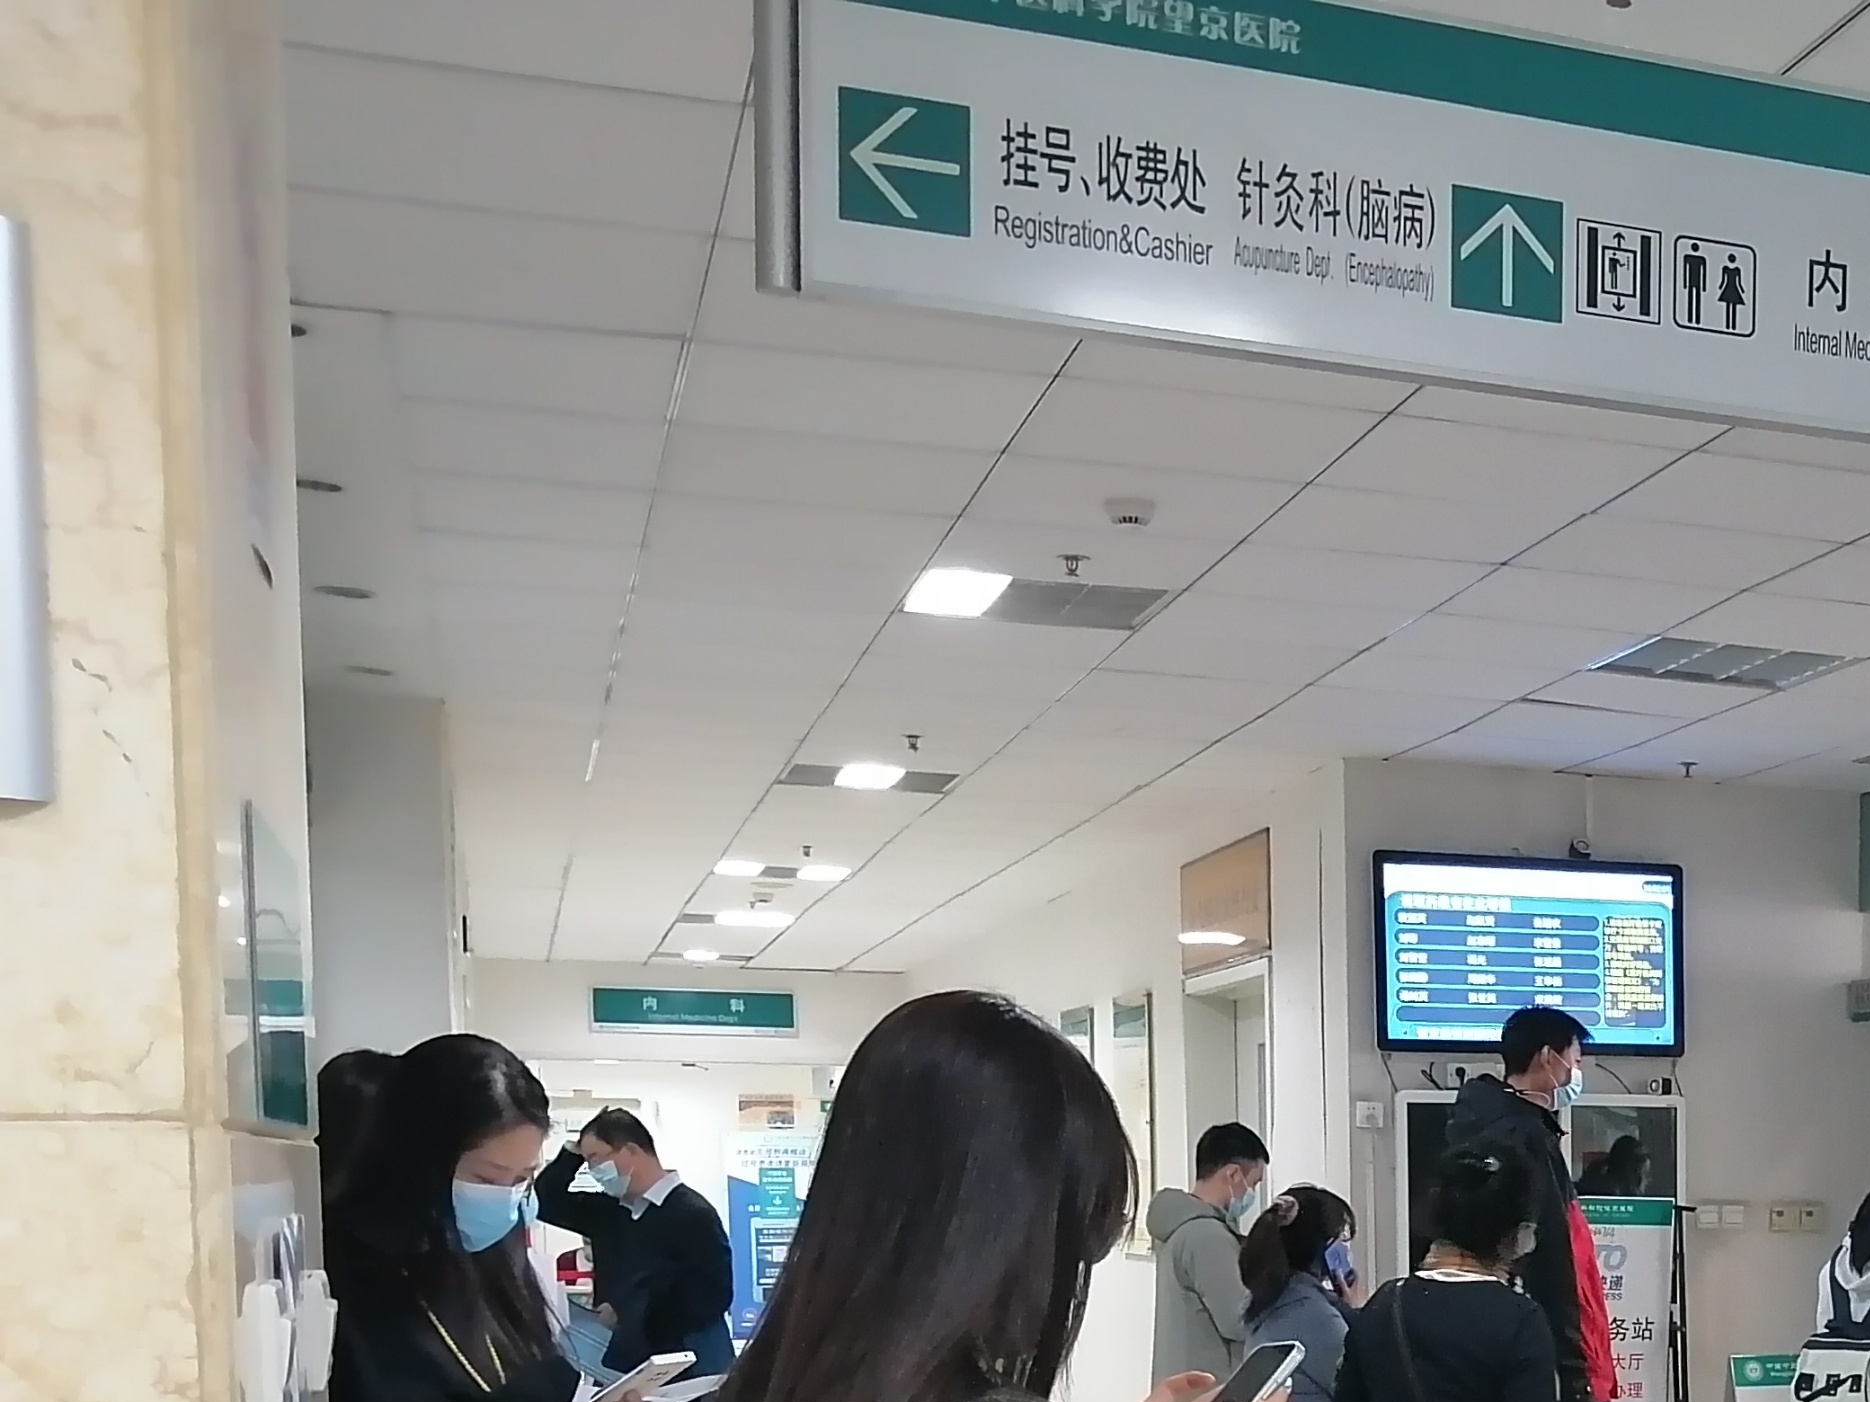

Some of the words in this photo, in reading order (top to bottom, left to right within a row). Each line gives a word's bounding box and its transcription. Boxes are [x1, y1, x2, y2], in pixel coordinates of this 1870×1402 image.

[1016, 0, 1300, 54] 学院望京医院
[1001, 117, 1207, 216] 挂号、收费处
[1235, 156, 1438, 252] 针灸科(脑病)
[994, 206, 1212, 268] Registration&Cashier
[1233, 240, 1301, 277] Acupuncture
[1344, 252, 1435, 302] (Encephalopathy)
[1794, 324, 1841, 359] Internal
[1609, 1317, 1654, 1342] 务站
